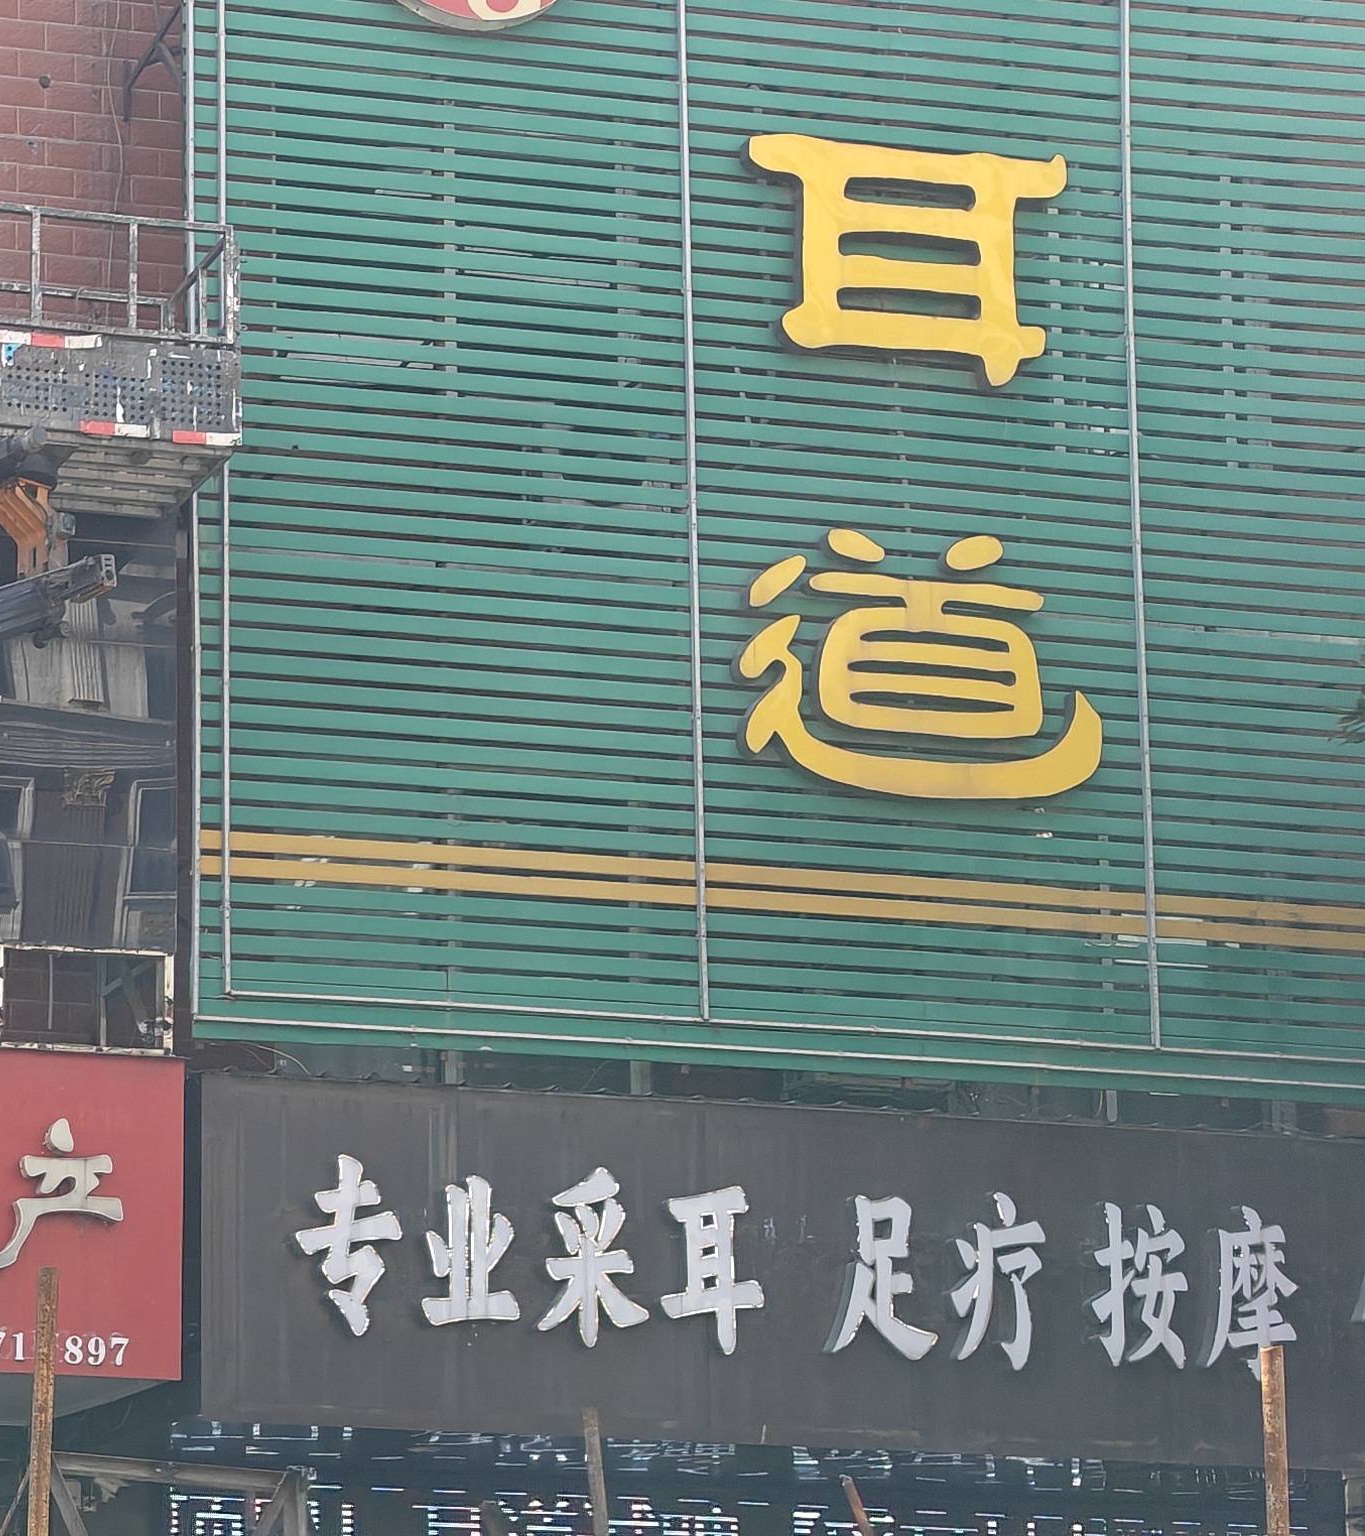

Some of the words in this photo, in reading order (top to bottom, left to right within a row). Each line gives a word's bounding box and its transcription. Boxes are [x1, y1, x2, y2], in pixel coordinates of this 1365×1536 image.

[734, 133, 1104, 800] 耳道
[294, 1152, 765, 1356] 专业采耳
[829, 1192, 1047, 1371] 足疗
[1091, 1202, 1301, 1380] 按摩
